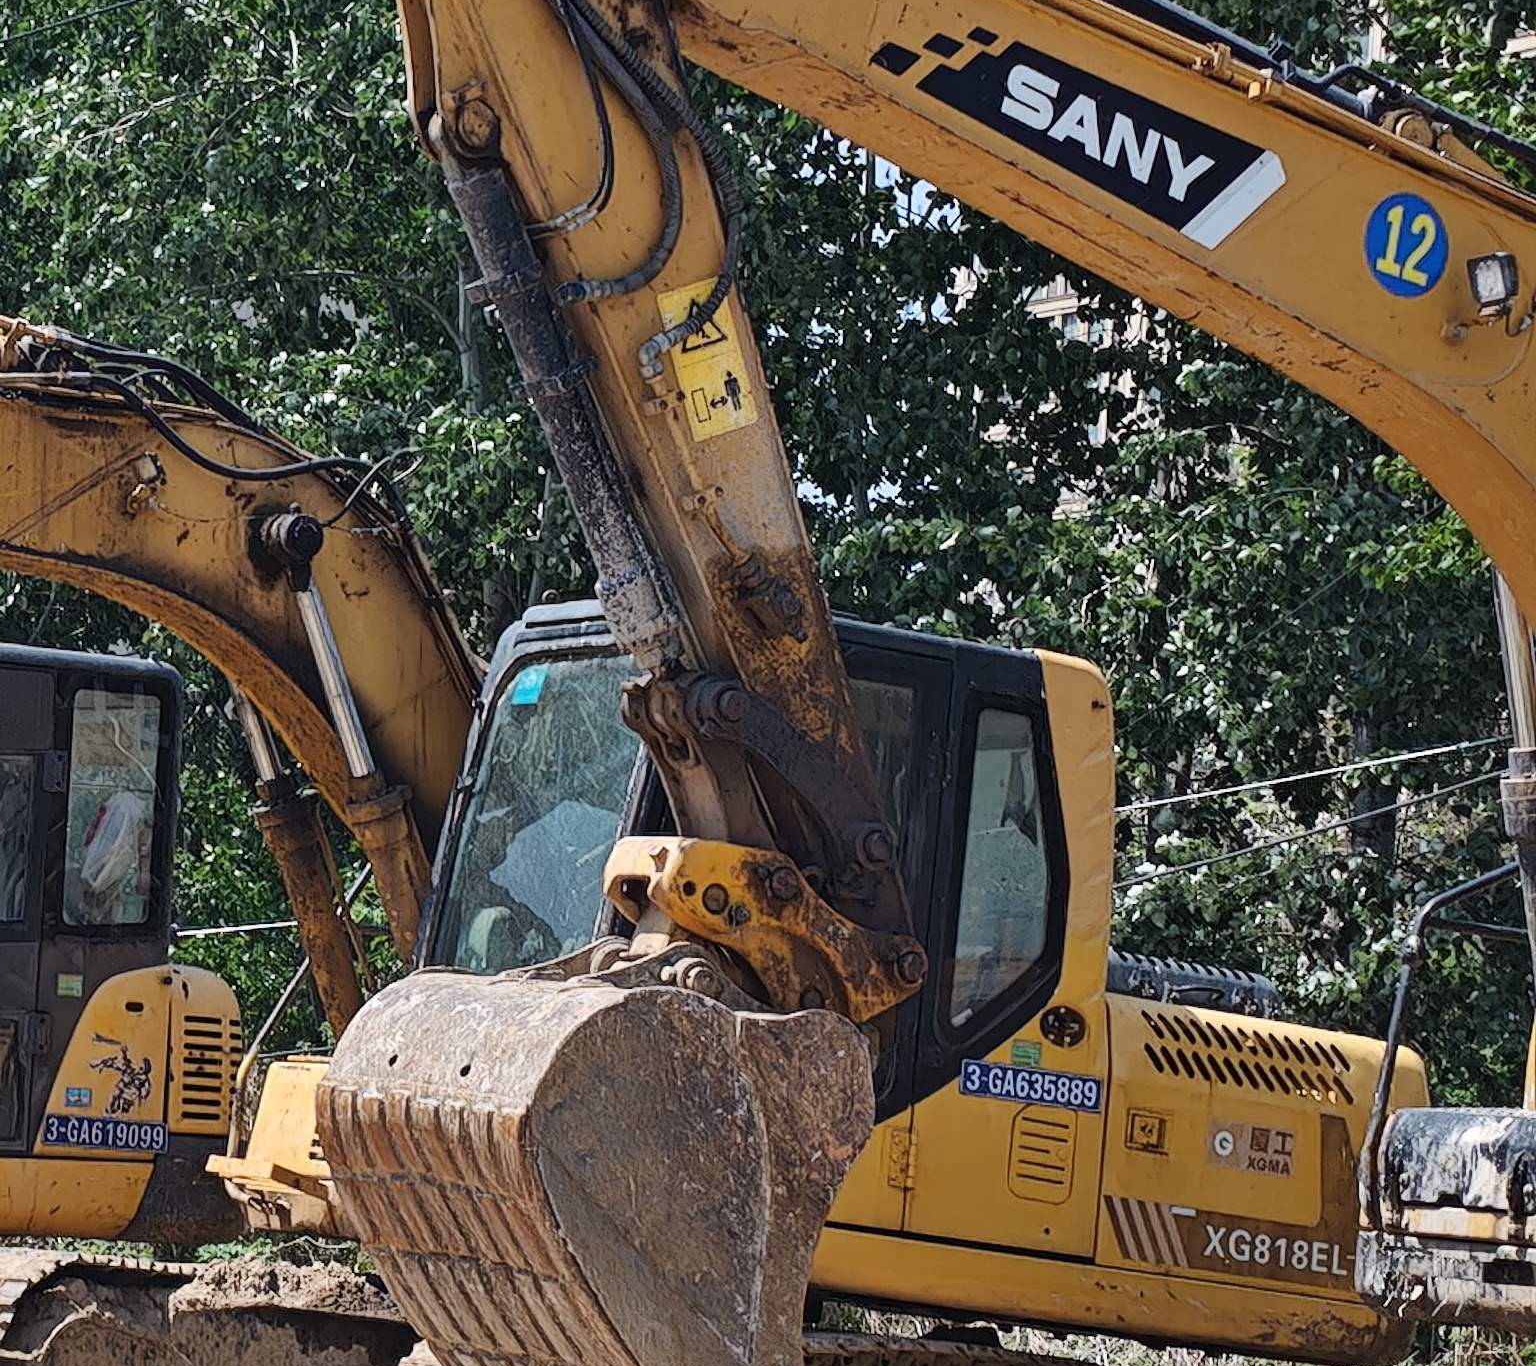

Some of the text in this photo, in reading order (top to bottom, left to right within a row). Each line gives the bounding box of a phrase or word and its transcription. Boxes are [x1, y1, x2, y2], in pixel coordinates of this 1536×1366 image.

[1000, 63, 1216, 203] SANY
[1375, 204, 1437, 287] 12
[965, 1063, 1098, 1108] 3-GA635889
[46, 1116, 165, 1150] 3-GA619099
